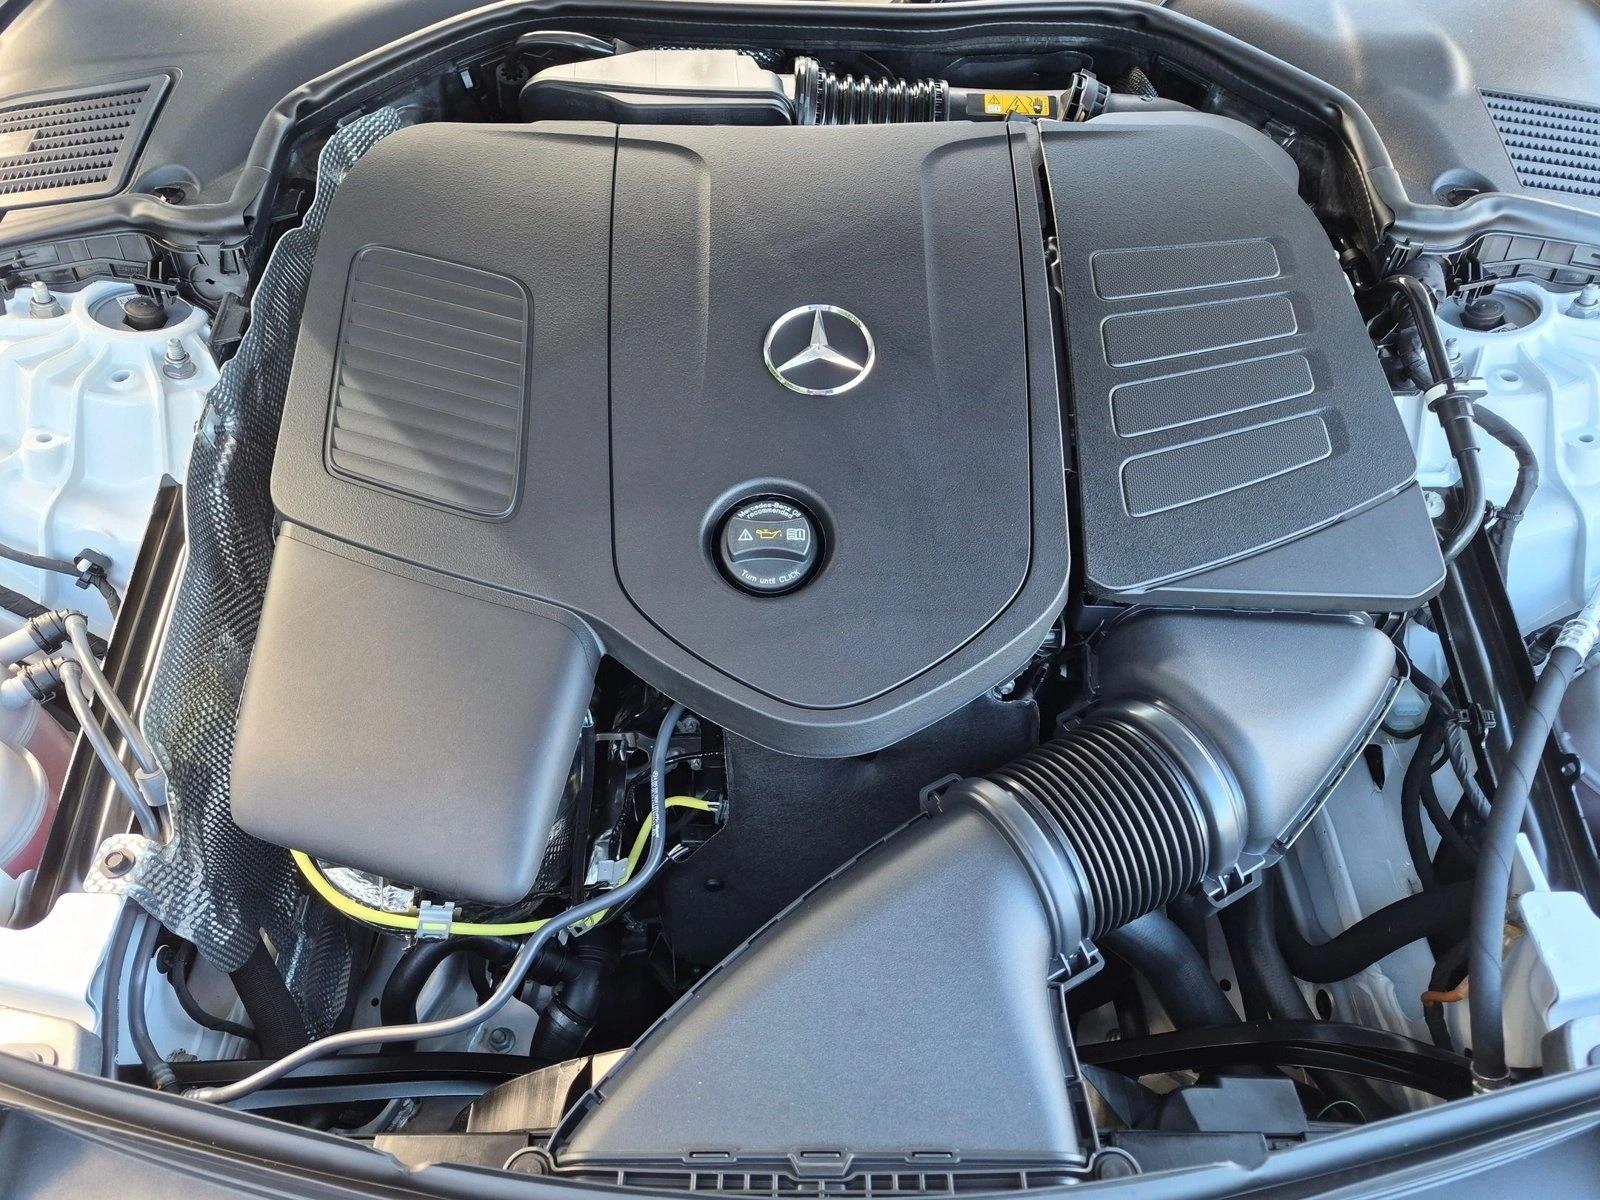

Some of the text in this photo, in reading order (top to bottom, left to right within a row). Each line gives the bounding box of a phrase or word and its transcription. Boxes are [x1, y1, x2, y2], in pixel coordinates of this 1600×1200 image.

[738, 502, 792, 518] Mercedes-Benz
[746, 507, 793, 519] recommended
[741, 569, 801, 585] Turn until CLICK
